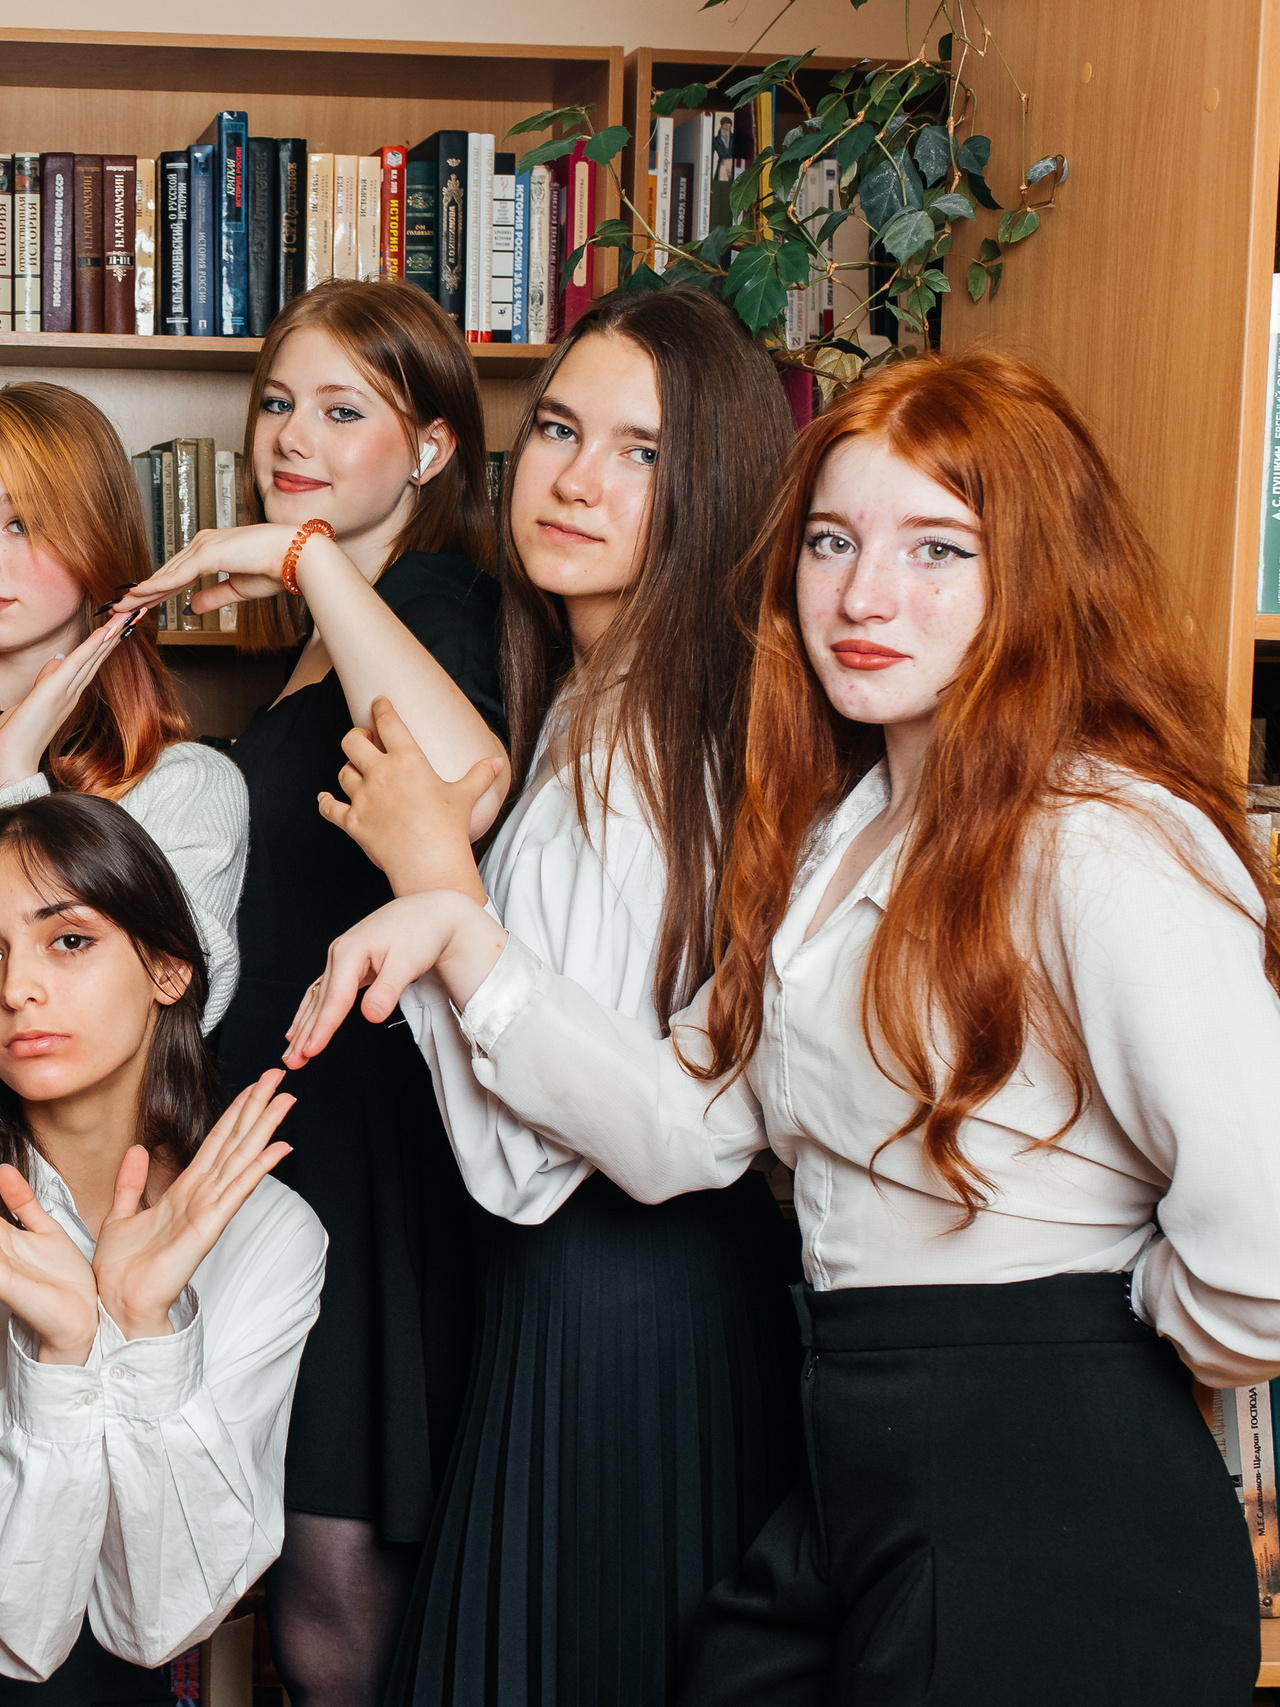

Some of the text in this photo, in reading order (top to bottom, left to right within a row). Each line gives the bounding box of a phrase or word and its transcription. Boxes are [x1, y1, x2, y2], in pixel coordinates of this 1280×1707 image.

[167, 173, 178, 211] РУССКОЙ
[226, 158, 236, 196] КРАТКАЯ
[178, 182, 187, 220] ИСТОРИИ
[28, 202, 37, 266] ИСТОРИЯ
[52, 173, 64, 307] ПОСОБИЕ ПО ИСТОРИИ СССР
[389, 199, 399, 252] ИСТОРИЯ
[198, 232, 207, 269] ИСТОРИЯ
[513, 184, 524, 326] ИСТОРИЯ РОССИИ ЗА 24 ЧАСА
[198, 271, 207, 304] РОССИИ
[1272, 445, 1280, 495] ПУШКИН
[1249, 1386, 1259, 1429] ГОСПОДА
